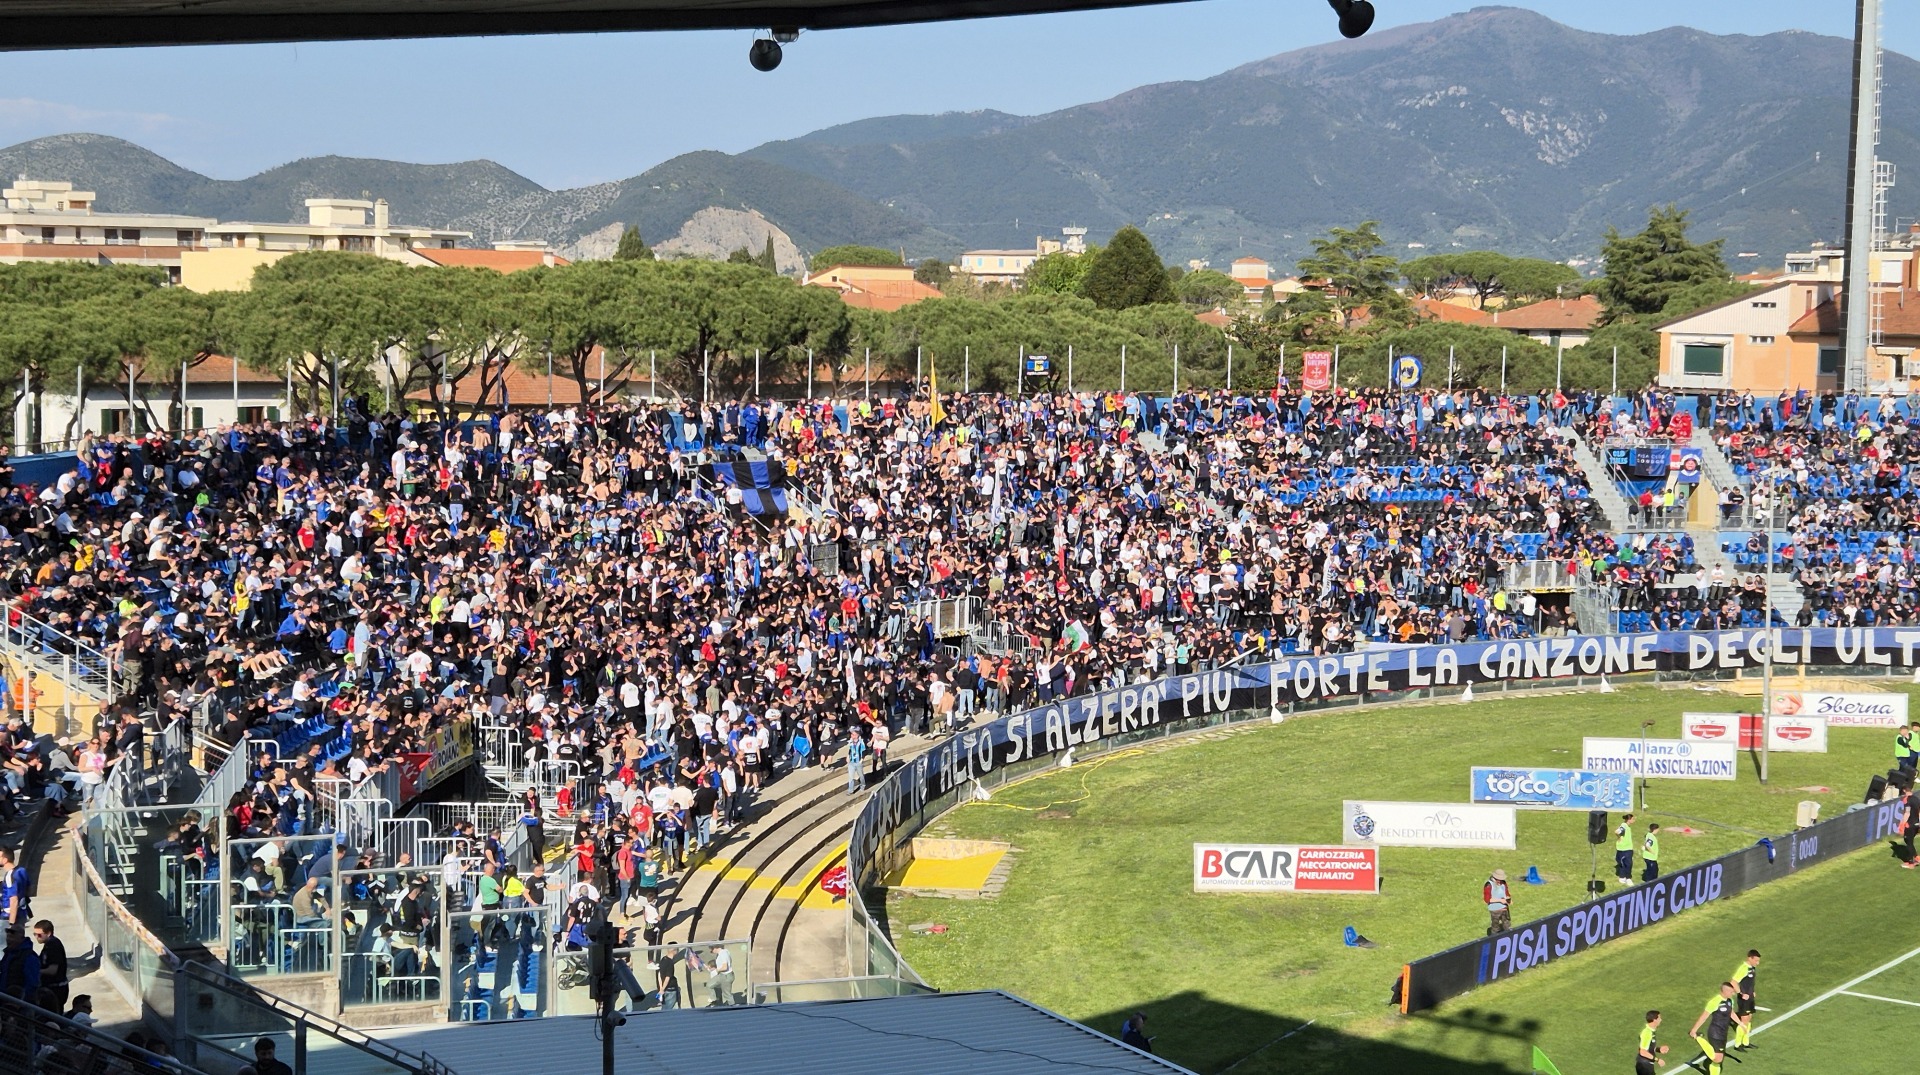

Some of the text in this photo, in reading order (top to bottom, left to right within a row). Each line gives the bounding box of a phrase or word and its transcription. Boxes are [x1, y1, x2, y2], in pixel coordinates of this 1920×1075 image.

[940, 727, 994, 793] ALTO
[1006, 714, 1034, 764] SI
[1270, 651, 1392, 704] FORTE
[1408, 648, 1459, 687] LA
[1479, 634, 1658, 677] CANZONE
[1689, 628, 1812, 670] DEGLI
[1816, 696, 1895, 715] Sberna
[1826, 716, 1897, 725] UBBLICITÀ
[1628, 742, 1673, 755] Alianz
[1646, 758, 1733, 776] ASSICURAZIONI
[1875, 800, 1906, 840] PIS
[1381, 828, 1505, 841] BENEDETTI GIOIELLERIA
[1300, 851, 1365, 860] CARROZZERIA
[1201, 850, 1293, 879] BCAR
[1299, 861, 1373, 870] MECCATRONICA
[1298, 871, 1355, 880] PNEUMATICI
[1492, 863, 1723, 980] PISA SPORTING CLUB
